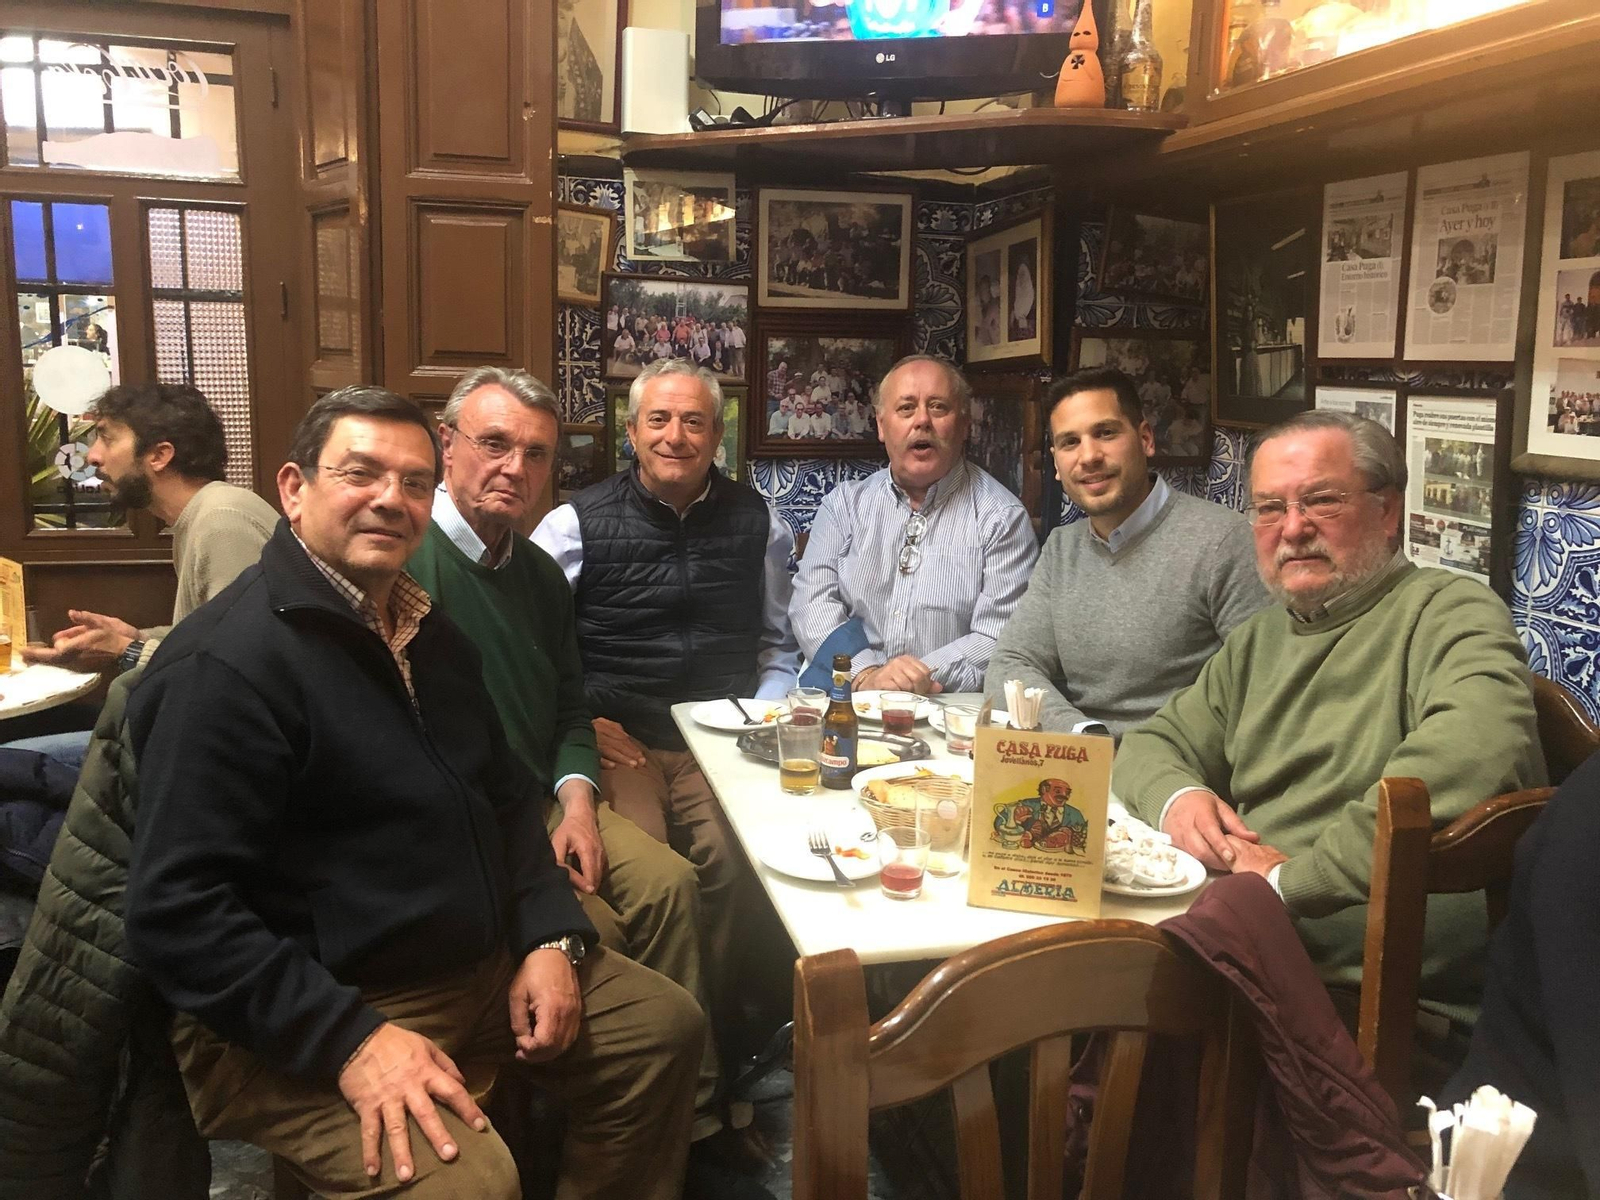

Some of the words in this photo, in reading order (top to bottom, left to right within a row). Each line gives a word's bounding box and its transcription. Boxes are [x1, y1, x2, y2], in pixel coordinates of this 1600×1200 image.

[885, 54, 896, 62] LG
[1441, 205, 1460, 216] Casa
[1461, 203, 1482, 214] Puga
[1440, 219, 1463, 235] Ayer
[1465, 219, 1474, 233] y
[1475, 214, 1496, 231] hoy
[1341, 262, 1358, 271] Casa
[1359, 261, 1376, 272] Puga
[996, 739, 1042, 758] CASA
[1044, 743, 1089, 763] PUGA
